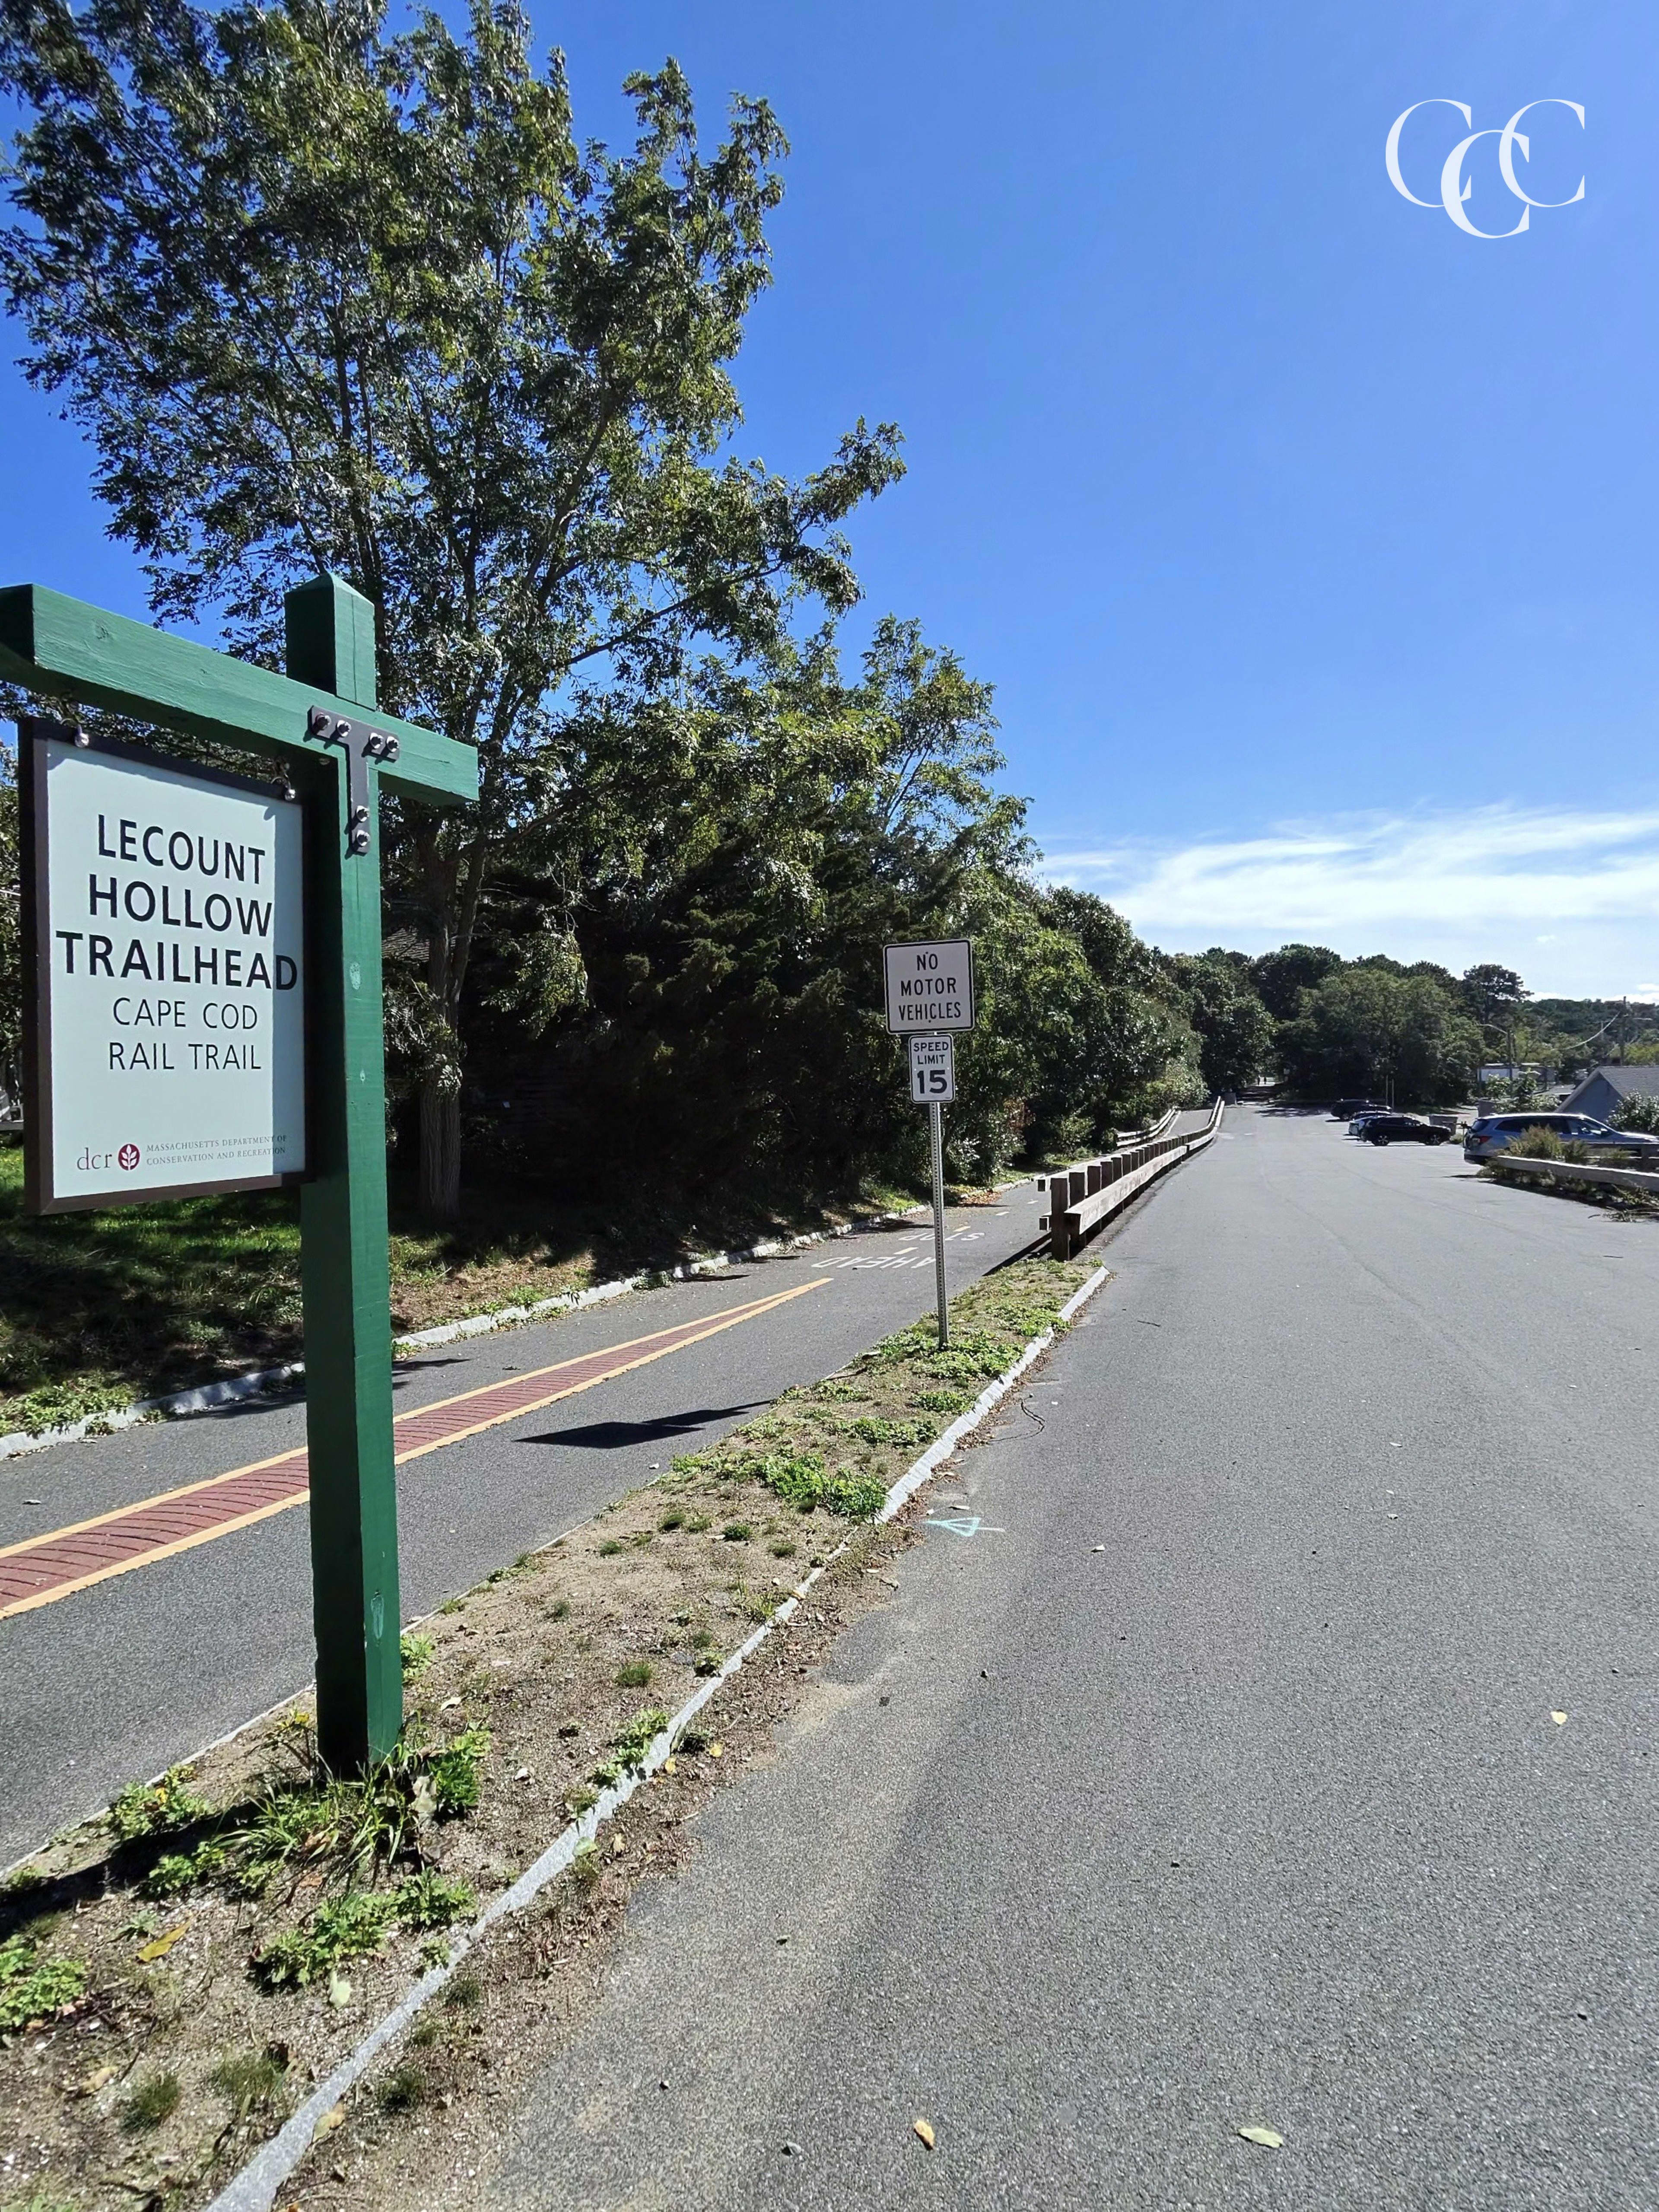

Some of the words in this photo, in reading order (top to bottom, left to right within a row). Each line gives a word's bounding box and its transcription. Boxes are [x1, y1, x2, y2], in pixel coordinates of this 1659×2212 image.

[98, 814, 266, 885] LECOUNT
[89, 873, 273, 937] HOLLOW
[55, 931, 298, 991] TRAILHEAD
[917, 953, 938, 971] NO
[900, 977, 957, 996] MOTOR
[113, 997, 186, 1028] CAPE
[203, 1003, 257, 1029] COD
[899, 1002, 961, 1021] VEHICLES
[109, 1042, 175, 1070] RAIL
[188, 1044, 261, 1070] TRAIL
[913, 1041, 949, 1052] SPEED
[917, 1054, 945, 1065] LIMIT
[917, 1069, 947, 1094] 15
[146, 1139, 219, 1152] MASSACHUSETTS
[222, 1136, 274, 1146] DEPARTMENT
[76, 1147, 112, 1170] dcr
[146, 1153, 214, 1165] CONSERVATION
[216, 1151, 234, 1159] AND
[237, 1147, 286, 1158] RECREATION
[811, 1257, 936, 1268] AHEAD
